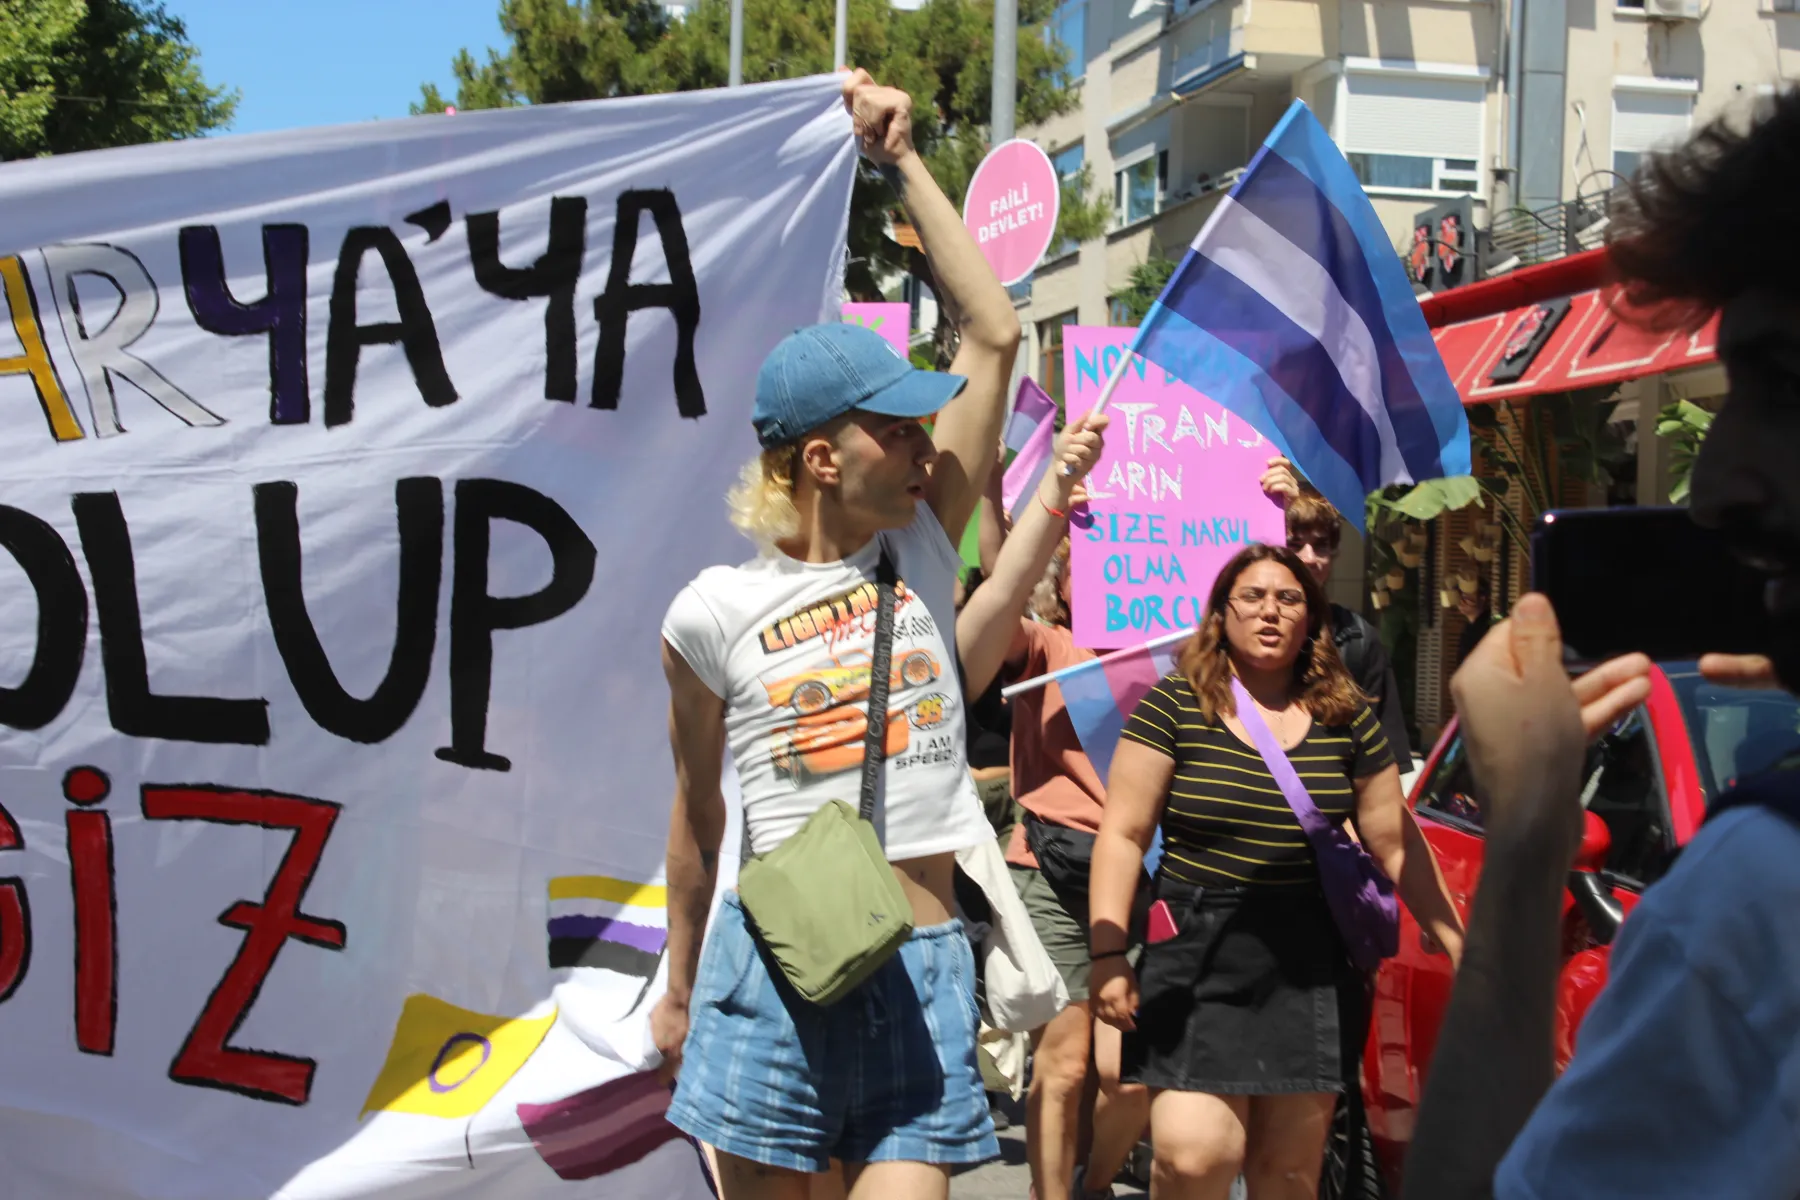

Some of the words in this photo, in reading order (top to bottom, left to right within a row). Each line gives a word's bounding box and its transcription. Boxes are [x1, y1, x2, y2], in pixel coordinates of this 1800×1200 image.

[978, 202, 1044, 243] DEVLET!
[1074, 341, 1147, 393] NON
[1084, 460, 1183, 502] LARIN
[1103, 552, 1187, 585] OLMA
